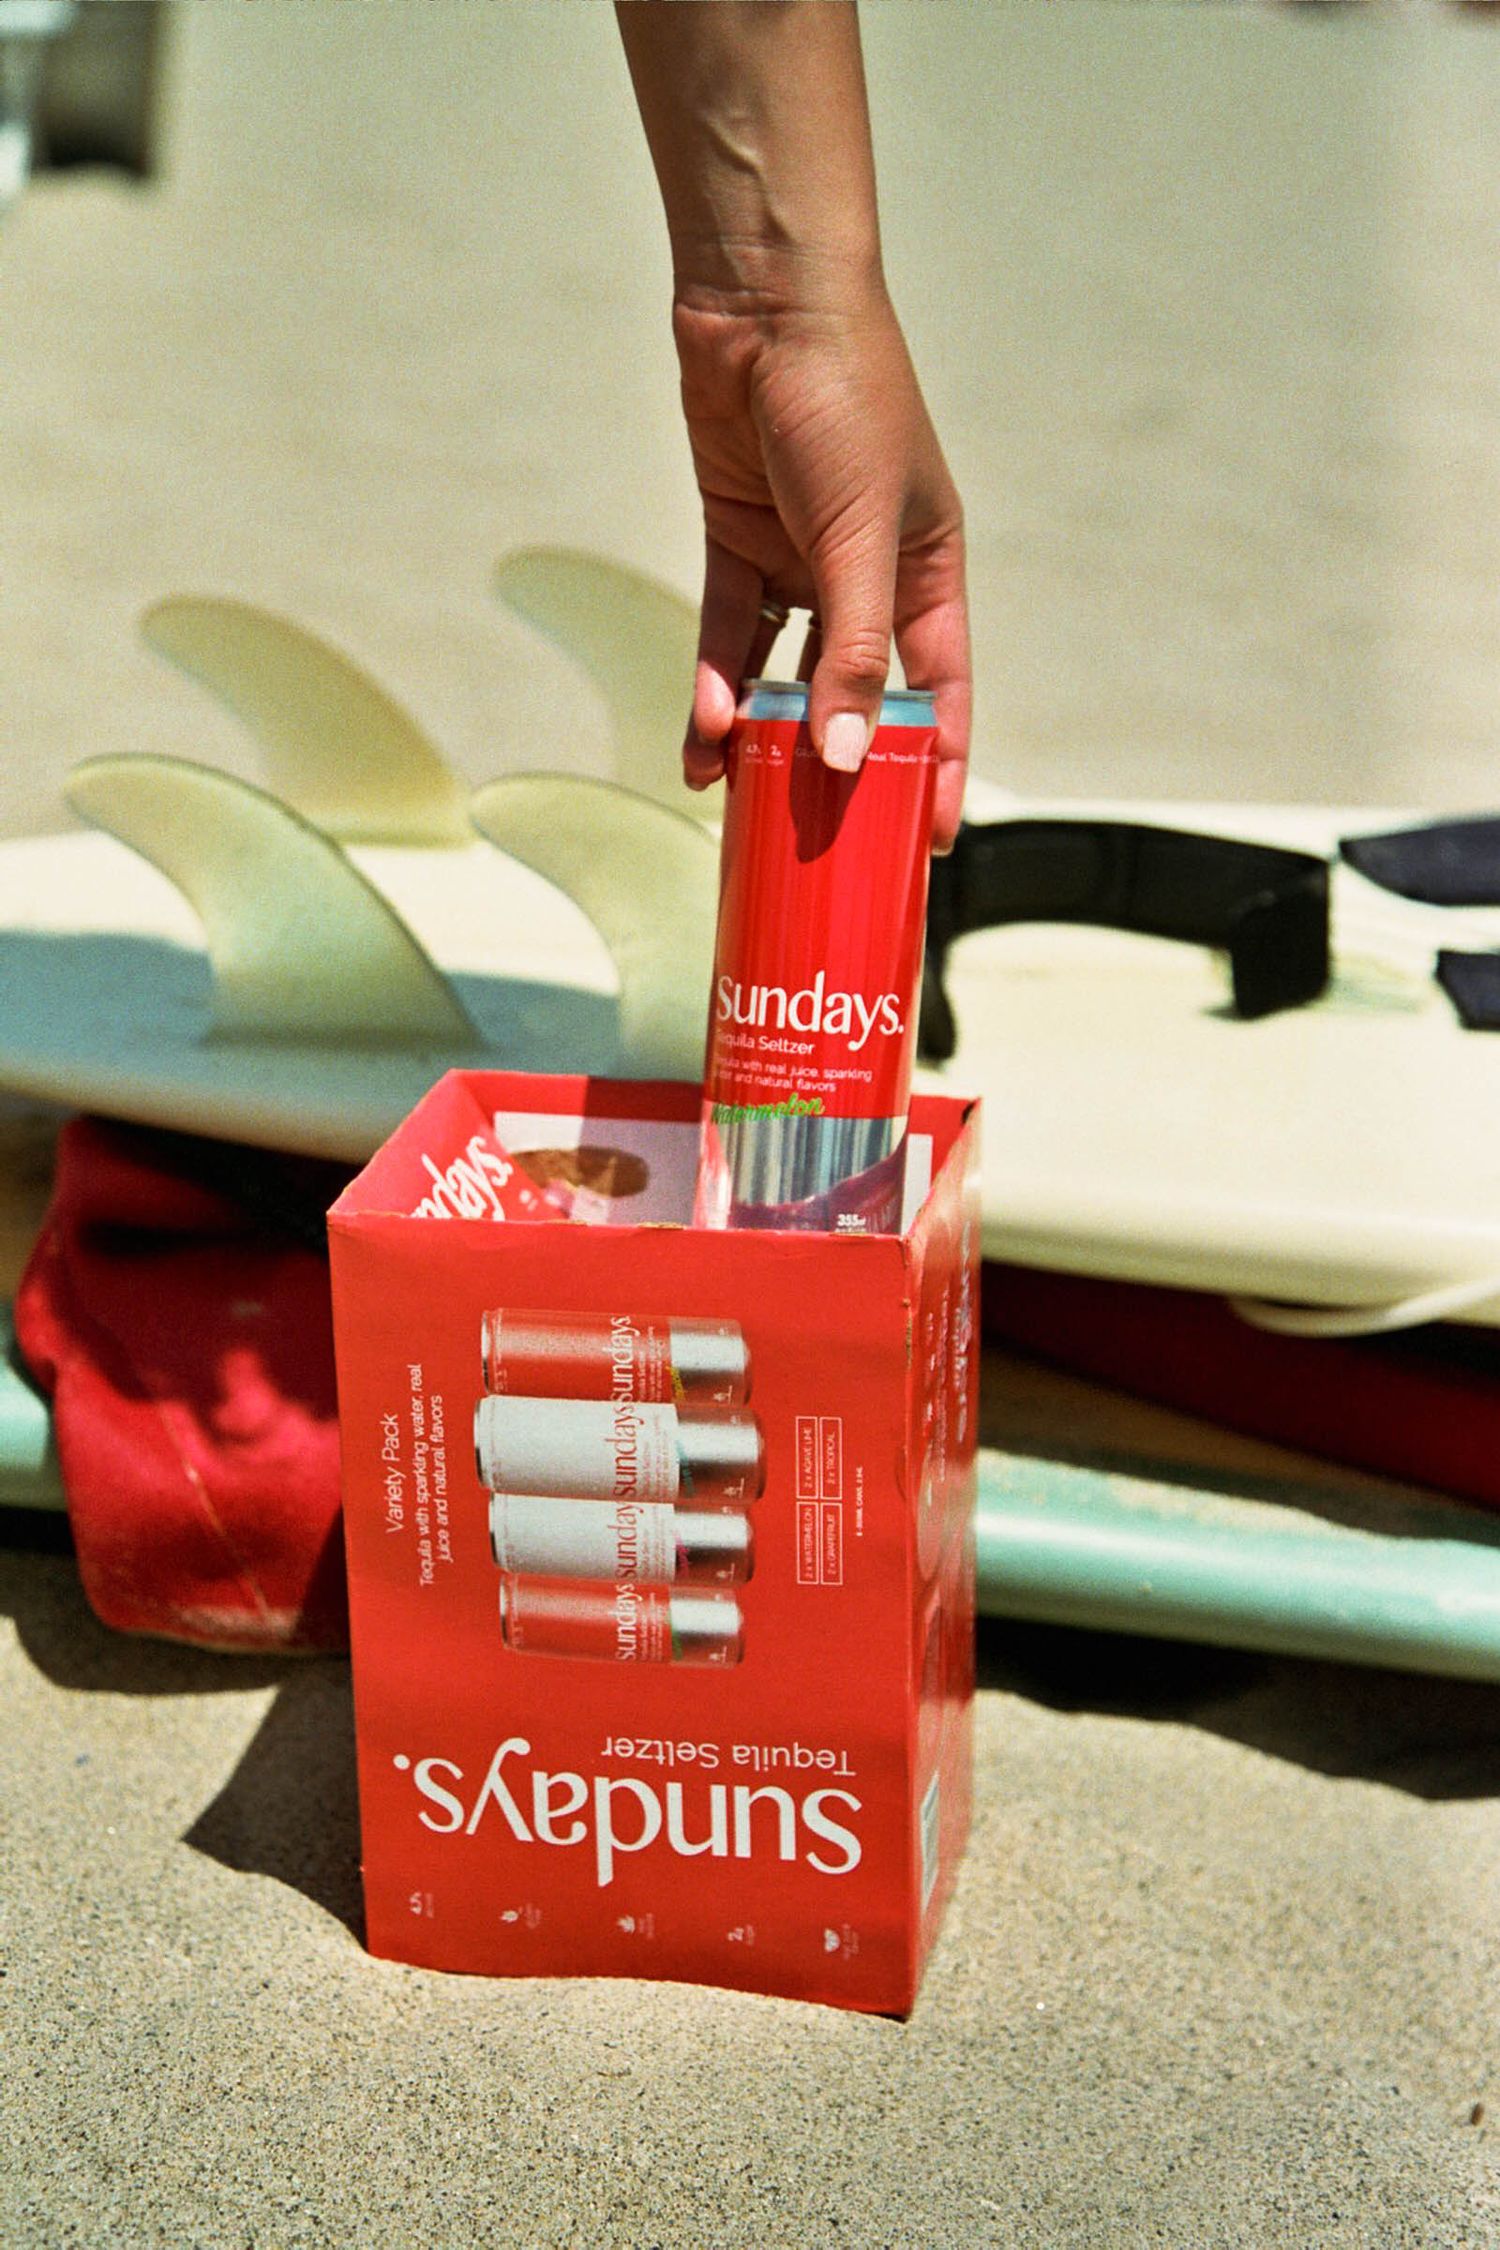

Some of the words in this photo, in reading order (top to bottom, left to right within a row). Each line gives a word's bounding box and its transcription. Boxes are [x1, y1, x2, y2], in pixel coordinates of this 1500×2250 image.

[758, 1036, 815, 1055] Seltzer
[755, 1074, 793, 1089] natural
[796, 1077, 837, 1092] flavors
[765, 1063, 787, 1075] real
[408, 1363, 423, 1392] real
[430, 1395, 445, 1443] flavors
[380, 1412, 401, 1462] Pack
[411, 1441, 431, 1504] sparkling
[431, 1447, 447, 1495] natural
[384, 1466, 407, 1534] Variety
[434, 1499, 448, 1525] and
[415, 1507, 430, 1535] with
[417, 1540, 435, 1586] Tequila
[437, 1529, 453, 1563] juice
[601, 1736, 720, 1769] Seltzer
[733, 1742, 857, 1776] Tequila
